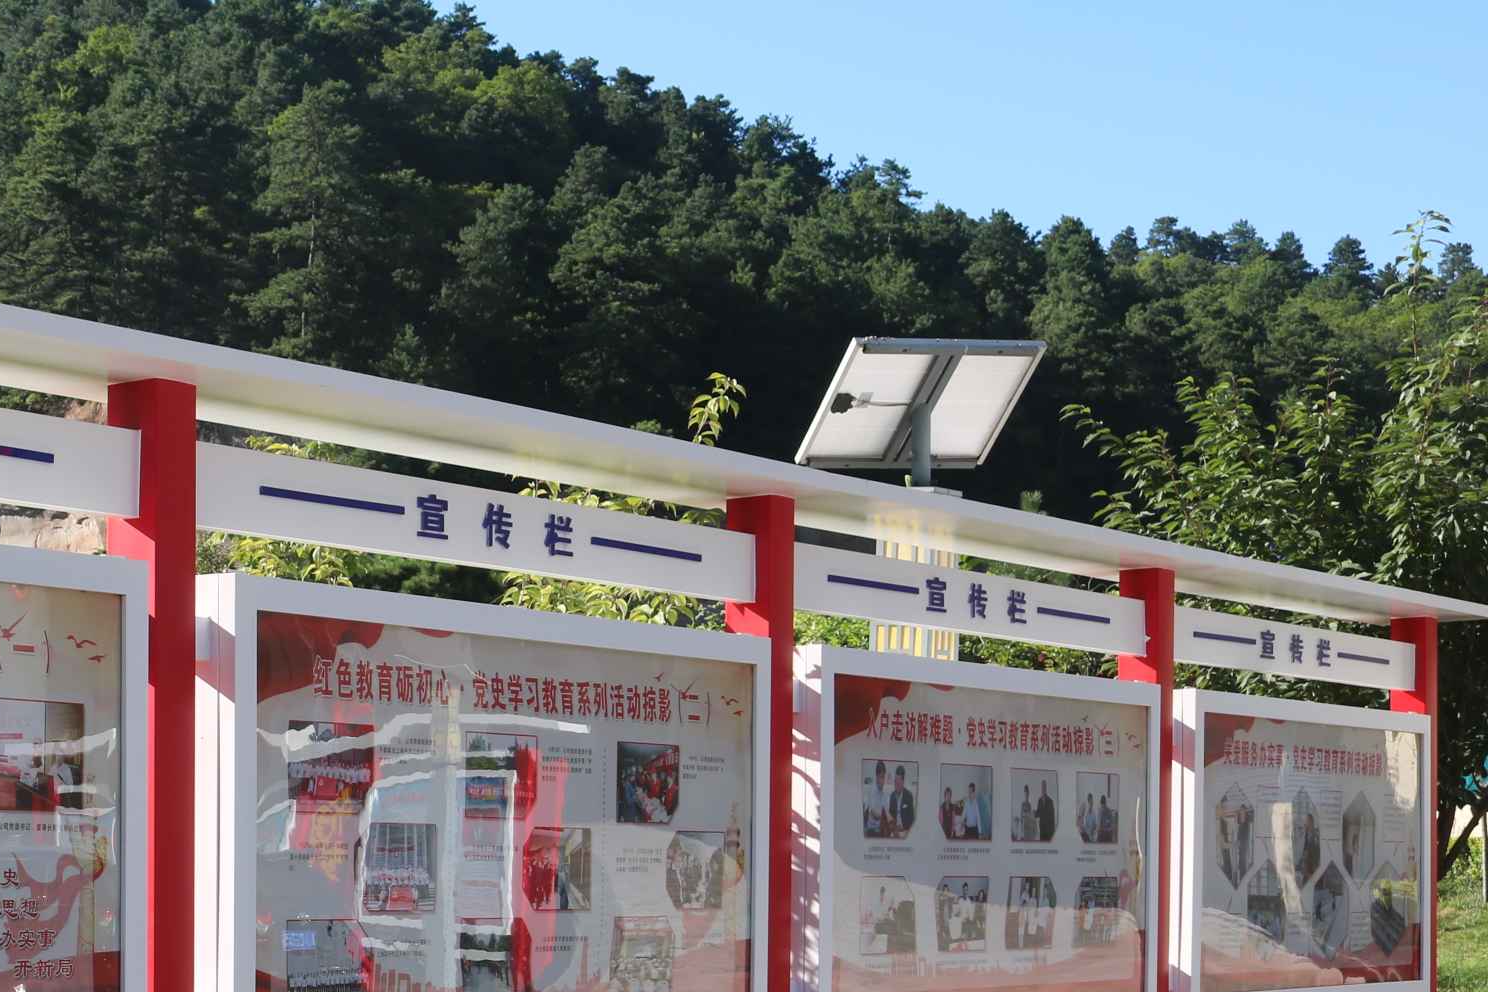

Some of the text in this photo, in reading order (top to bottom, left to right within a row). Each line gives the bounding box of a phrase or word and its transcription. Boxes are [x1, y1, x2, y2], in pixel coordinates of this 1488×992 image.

[416, 494, 574, 557] 宣传栏
[925, 577, 1028, 625] 宣传栏
[1259, 629, 1332, 668] 宣传栏
[14, 959, 73, 977] 开新局
